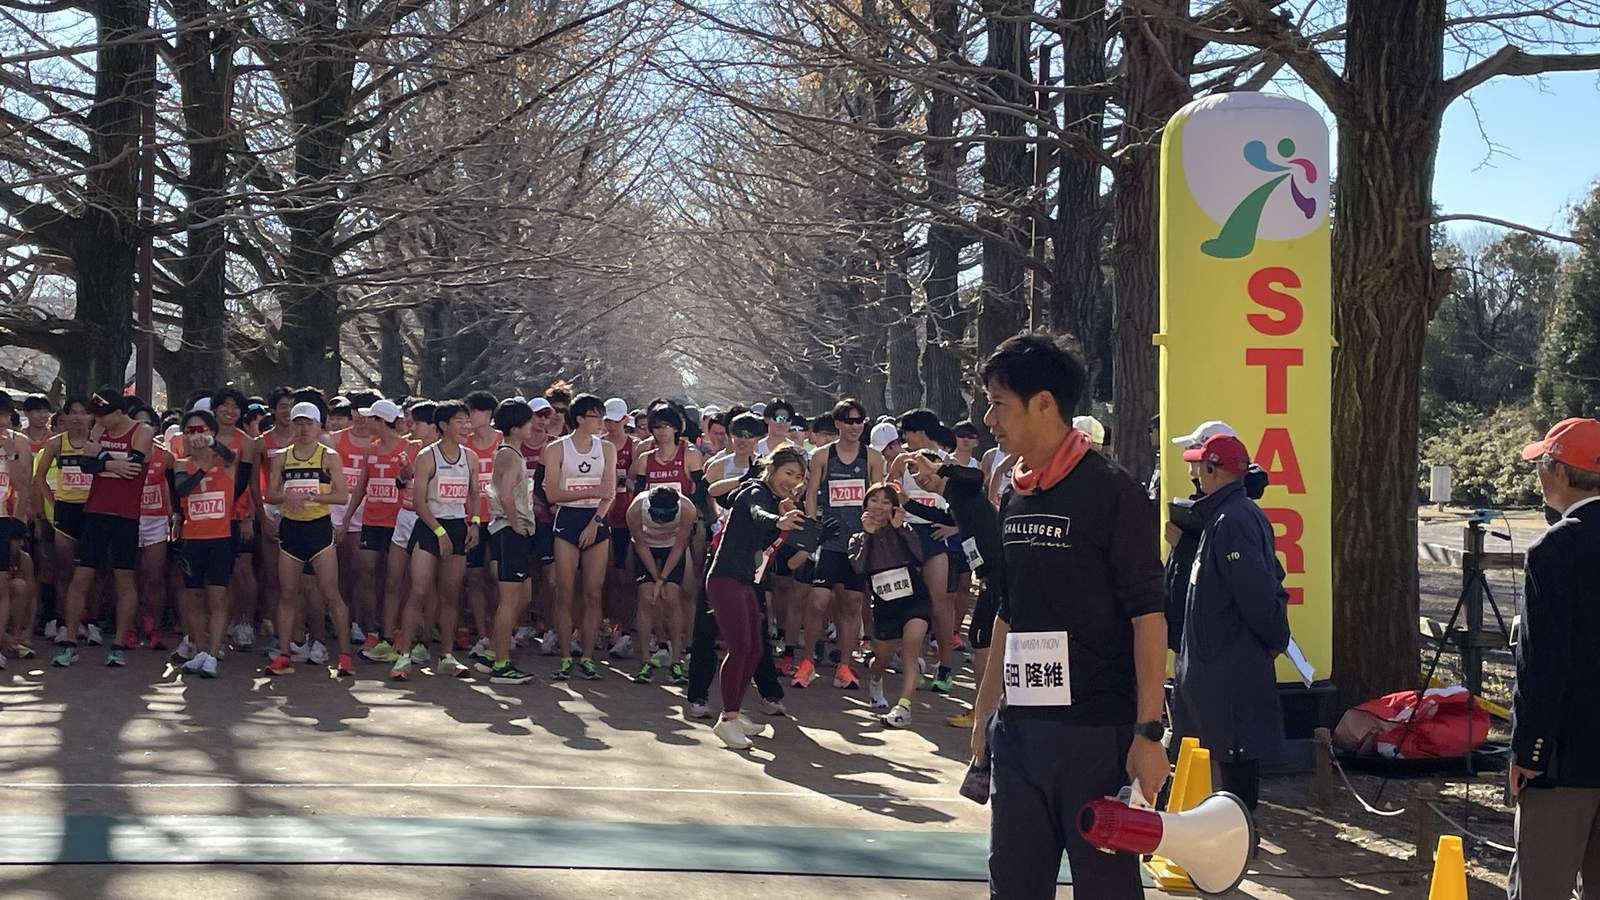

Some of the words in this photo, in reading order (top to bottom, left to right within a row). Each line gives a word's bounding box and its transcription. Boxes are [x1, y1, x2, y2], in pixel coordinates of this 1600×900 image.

[1246, 267, 1306, 604] STAR
[831, 487, 863, 500] A2014
[191, 500, 223, 513] A2074
[1004, 523, 1062, 538] CHALLENGER
[1025, 662, 1064, 688] 隆維
